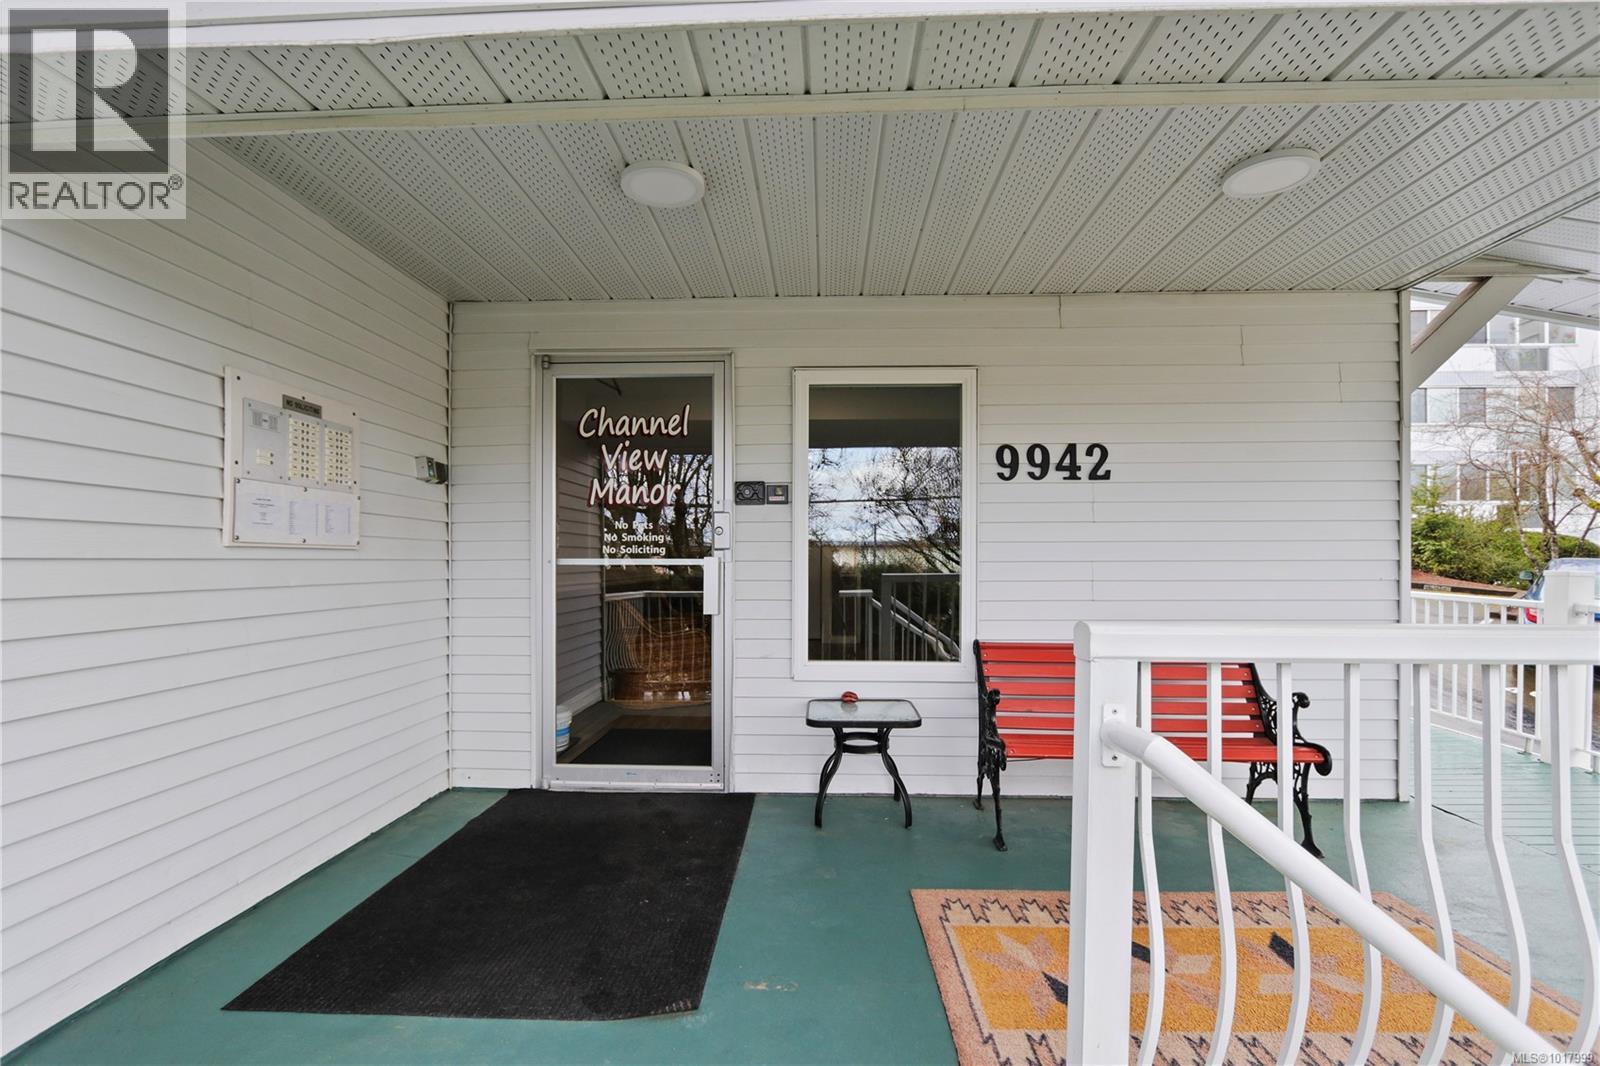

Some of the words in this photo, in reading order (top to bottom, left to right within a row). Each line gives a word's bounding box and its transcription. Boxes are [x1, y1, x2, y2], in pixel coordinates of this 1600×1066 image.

[577, 404, 691, 439] Channel
[601, 440, 669, 472] View
[995, 443, 1112, 481] 9942
[588, 478, 682, 507] Manor
[604, 533, 618, 542] No
[621, 532, 665, 544] Smoking
[615, 521, 629, 530] No
[632, 521, 654, 530] Pts
[602, 545, 616, 554] No
[620, 545, 666, 556] Soliciting
